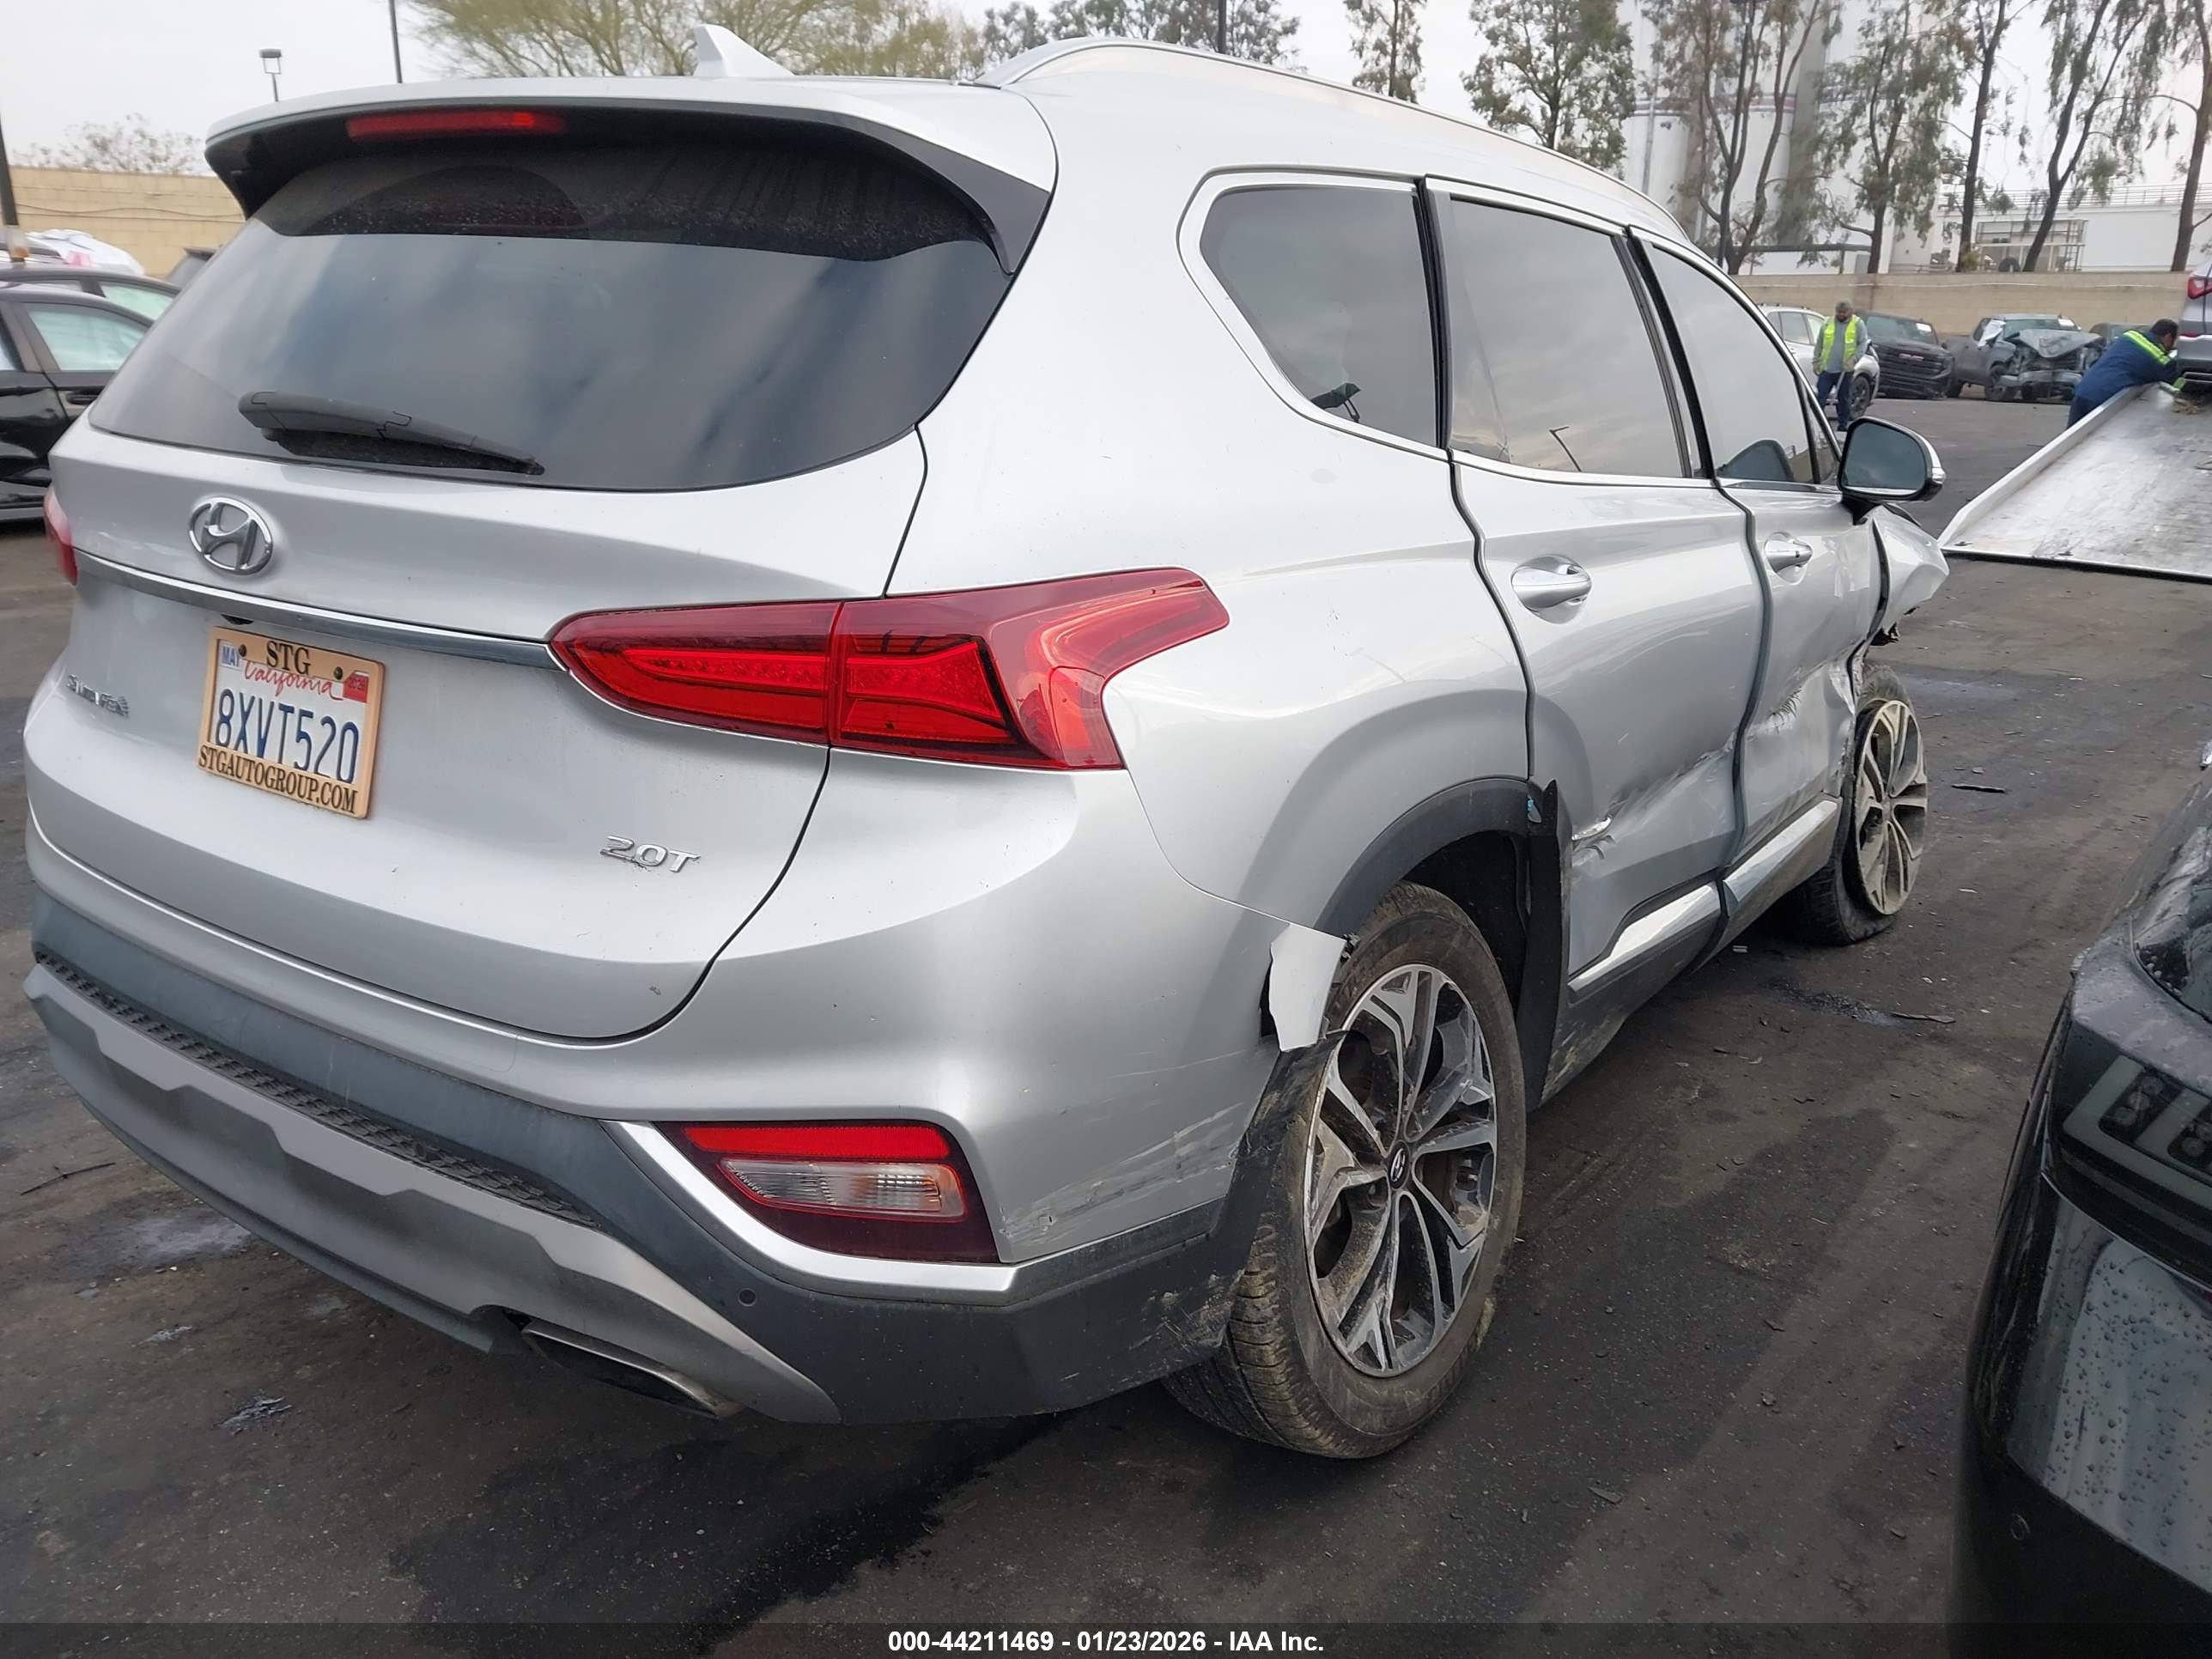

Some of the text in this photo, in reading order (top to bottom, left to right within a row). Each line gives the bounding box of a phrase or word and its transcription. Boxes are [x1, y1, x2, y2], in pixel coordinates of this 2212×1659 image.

[266, 641, 311, 676] STG
[215, 688, 359, 785] 8XVT520
[198, 744, 358, 813] STGAUTOGROUP.COM
[599, 835, 701, 872] 2.0T
